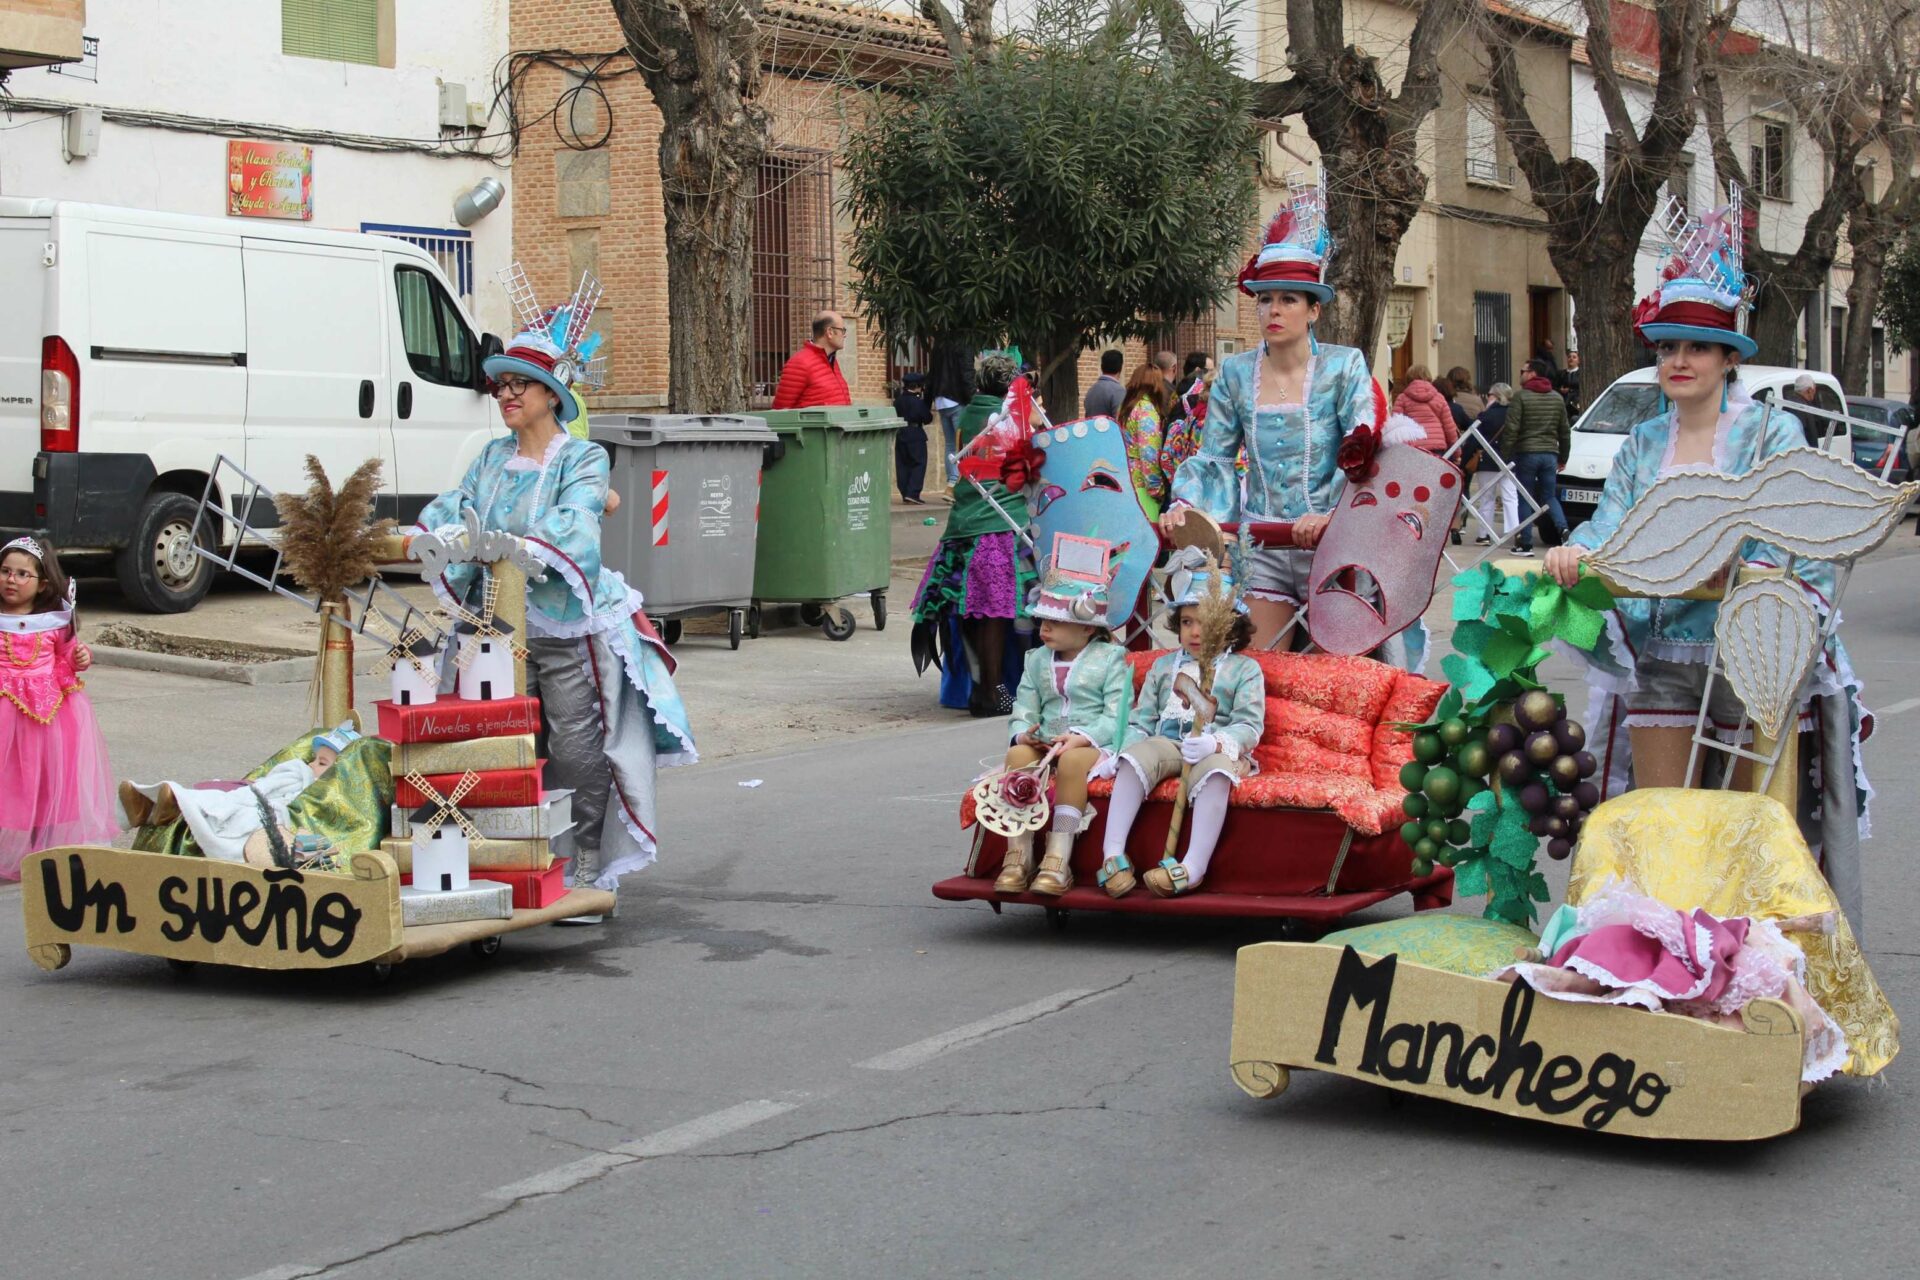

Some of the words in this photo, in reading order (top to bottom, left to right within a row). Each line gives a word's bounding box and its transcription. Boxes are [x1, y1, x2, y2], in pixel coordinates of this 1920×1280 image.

[249, 177, 257, 191] y
[1567, 490, 1589, 502] 9151
[420, 714, 471, 736] Novelas
[476, 710, 528, 736] ejemplares
[41, 853, 136, 933] Un
[159, 868, 362, 959] sueño
[1314, 944, 1671, 1130] Manchego
